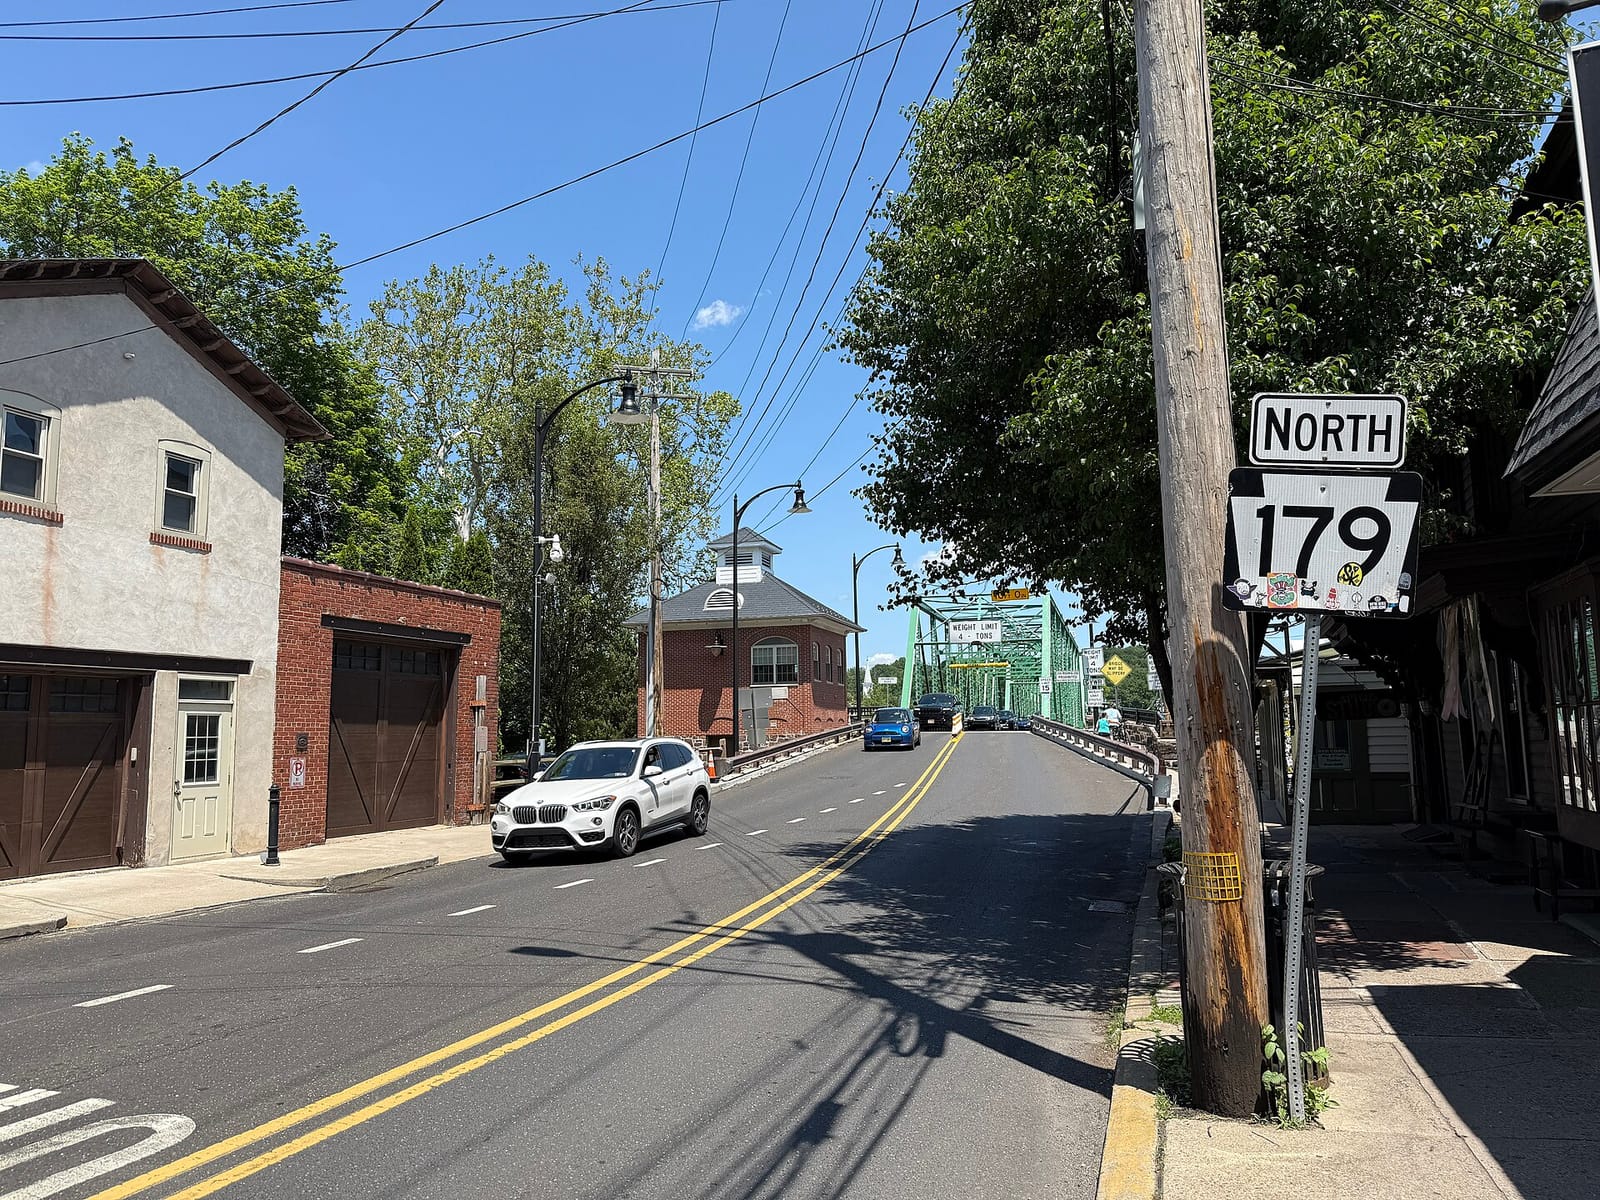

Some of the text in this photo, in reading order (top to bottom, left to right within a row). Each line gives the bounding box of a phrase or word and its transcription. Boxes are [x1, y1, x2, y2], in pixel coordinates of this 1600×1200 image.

[1264, 407, 1393, 453] NORTH
[1256, 504, 1392, 579] 179
[952, 622, 998, 631] WEIGHT LIMIT
[976, 632, 993, 640] TONS
